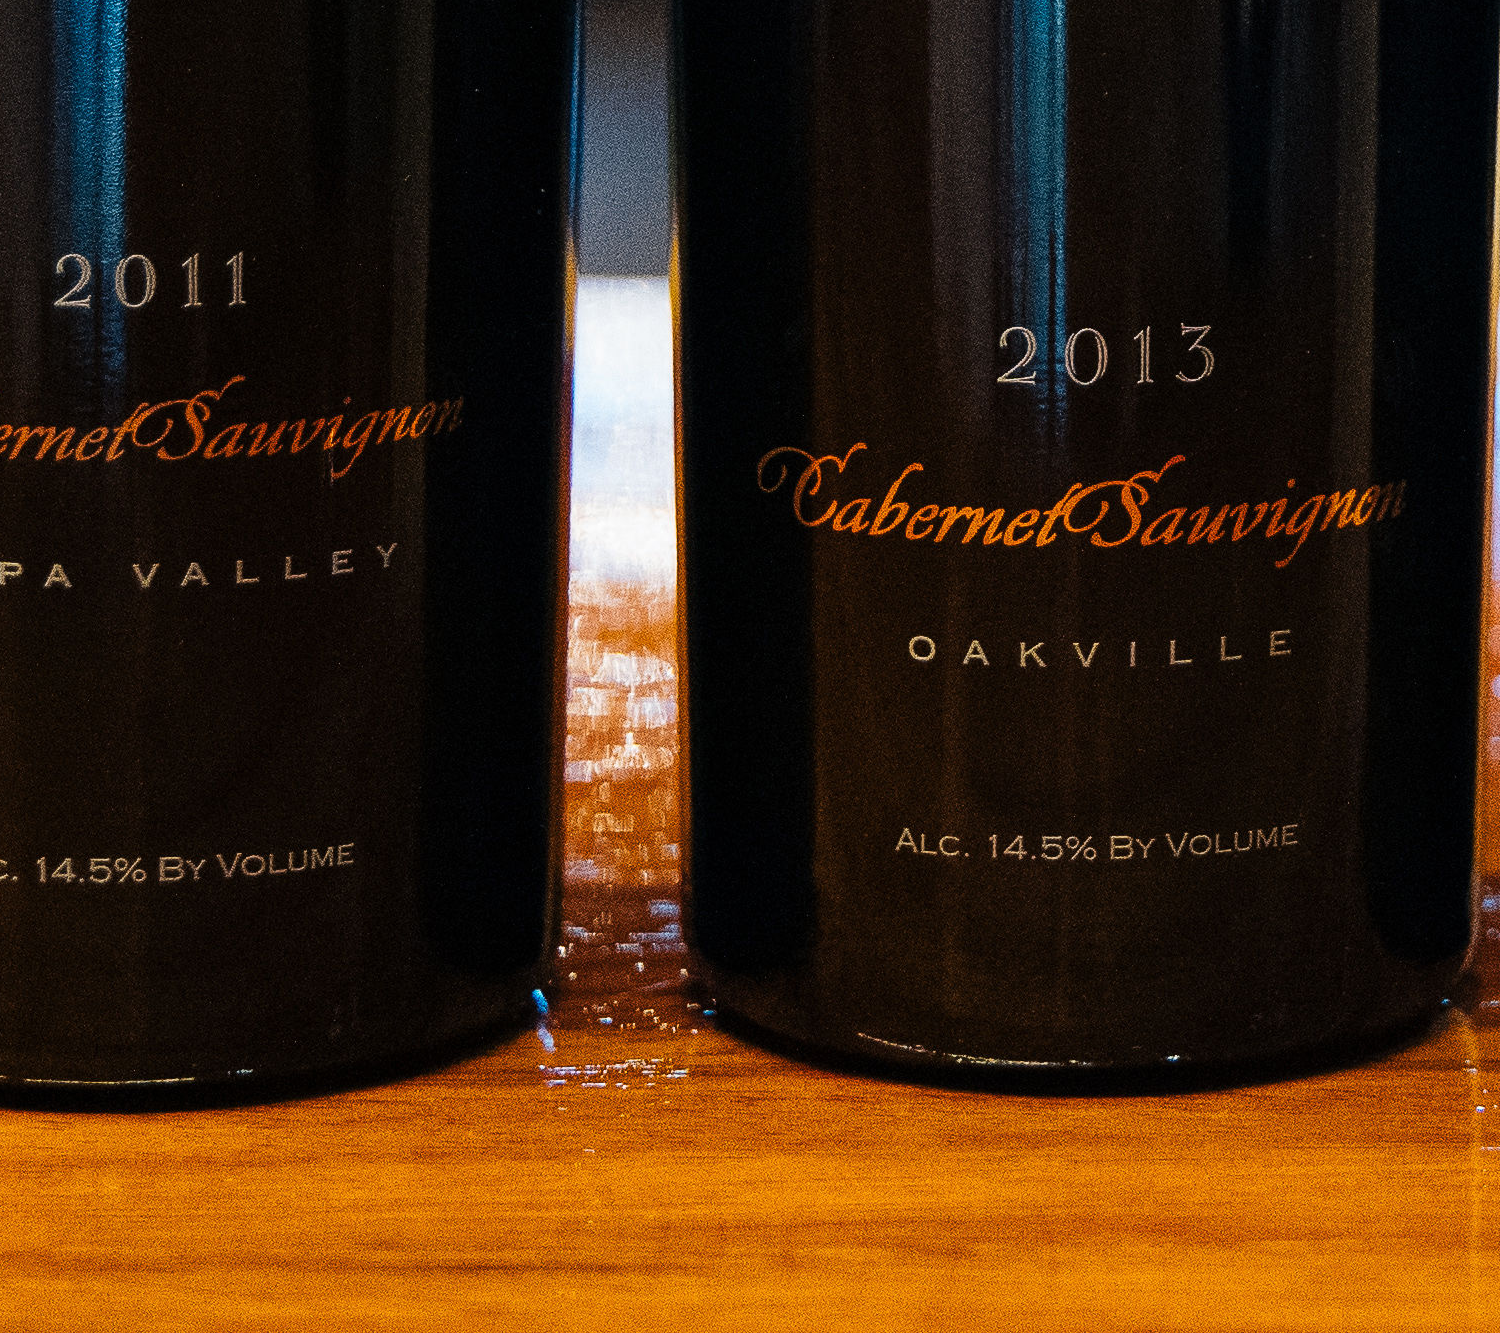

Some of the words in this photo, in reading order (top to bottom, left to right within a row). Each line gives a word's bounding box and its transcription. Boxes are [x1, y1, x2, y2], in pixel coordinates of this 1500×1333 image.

[53, 250, 248, 309] 2011
[997, 322, 1216, 386] 2013
[128, 374, 466, 481] Sauvignon
[756, 442, 1082, 548] Cabernet
[1060, 454, 1407, 569] Sauvignon
[132, 540, 399, 590] VALLEY
[908, 630, 1293, 668] OAKVILLE
[35, 855, 148, 884] 14.5%
[216, 842, 356, 880] VOLUME
[988, 832, 1098, 861] 14.5%
[1165, 824, 1300, 858] VOLUME
